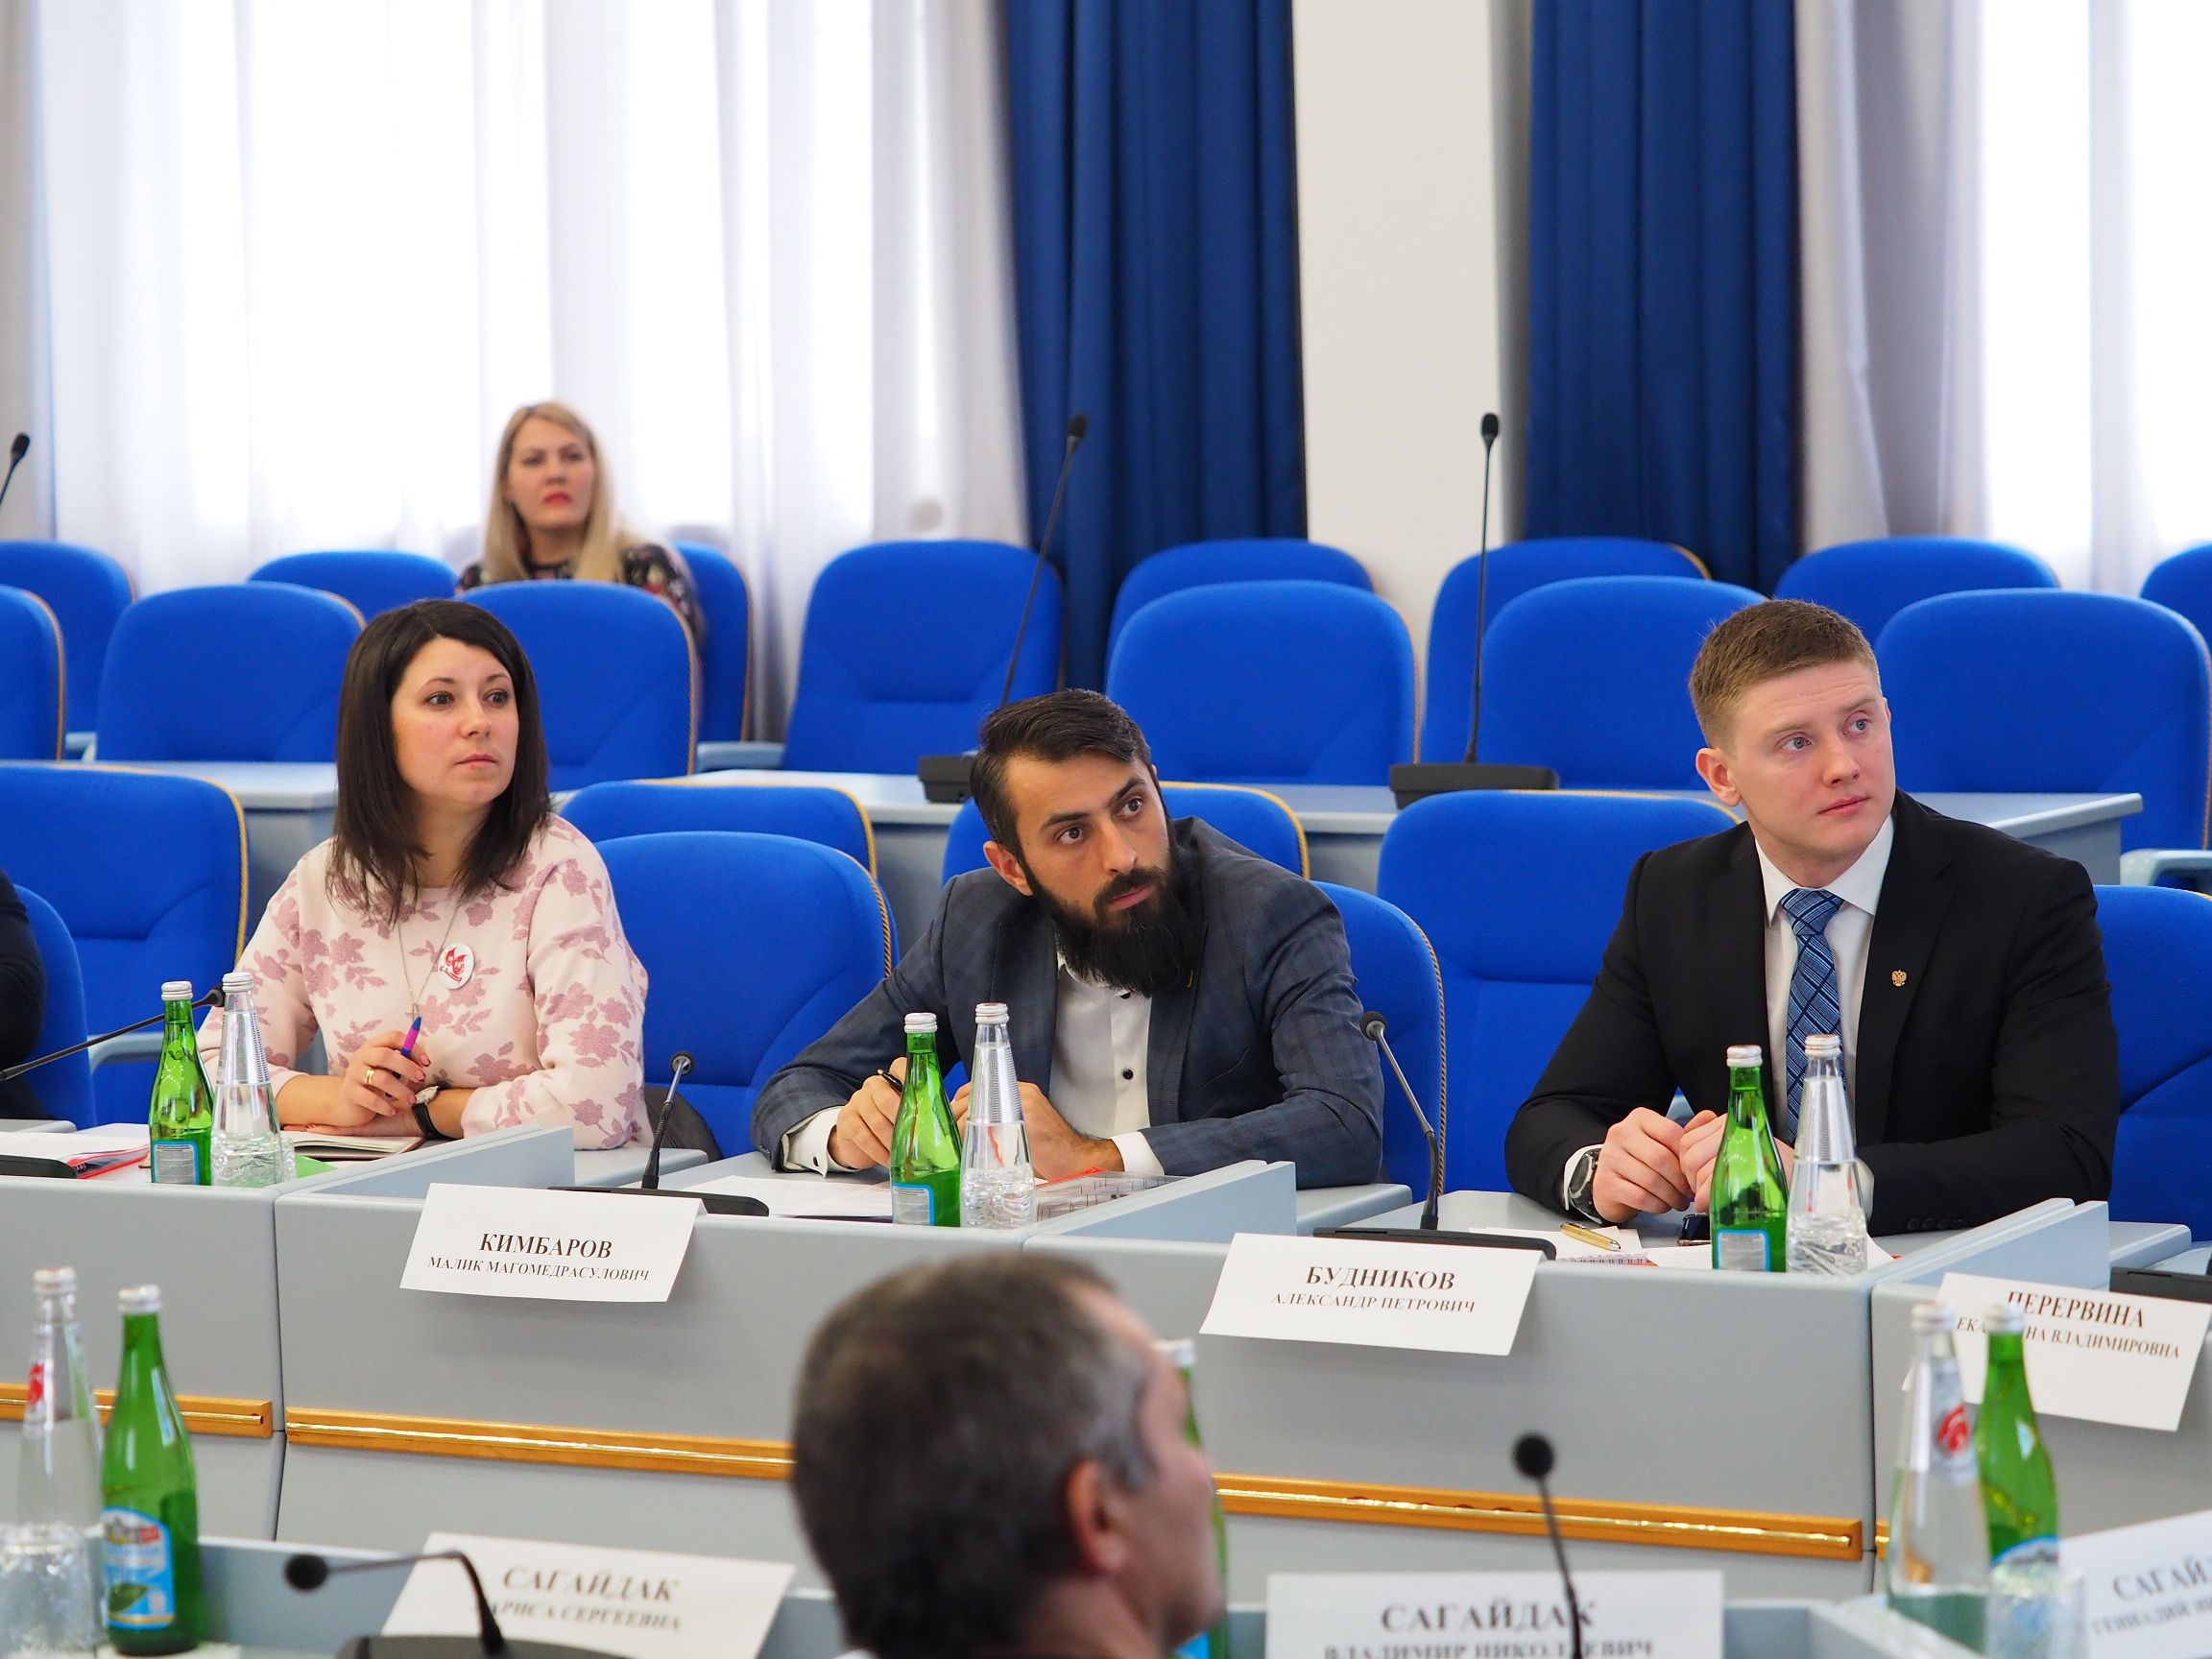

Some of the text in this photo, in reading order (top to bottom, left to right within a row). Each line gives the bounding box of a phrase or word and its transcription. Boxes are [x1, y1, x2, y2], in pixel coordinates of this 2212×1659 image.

[479, 1233, 613, 1259] КИМБАРОВ
[427, 1257, 651, 1282] МАЛИК МАГОМЕДРАСУЛОВИЧ
[1306, 1265, 1456, 1291] БУДНИКОВ
[1271, 1292, 1476, 1313] АЛЕКСАНДР ПЕТРОВИЧ
[2008, 1290, 2144, 1329] ПЕРЕРВИНА
[2051, 1329, 2180, 1359] ВЛАДИМИРОВНА
[503, 1565, 680, 1601] САГАЙДАК
[480, 1599, 554, 1620] АРИСА
